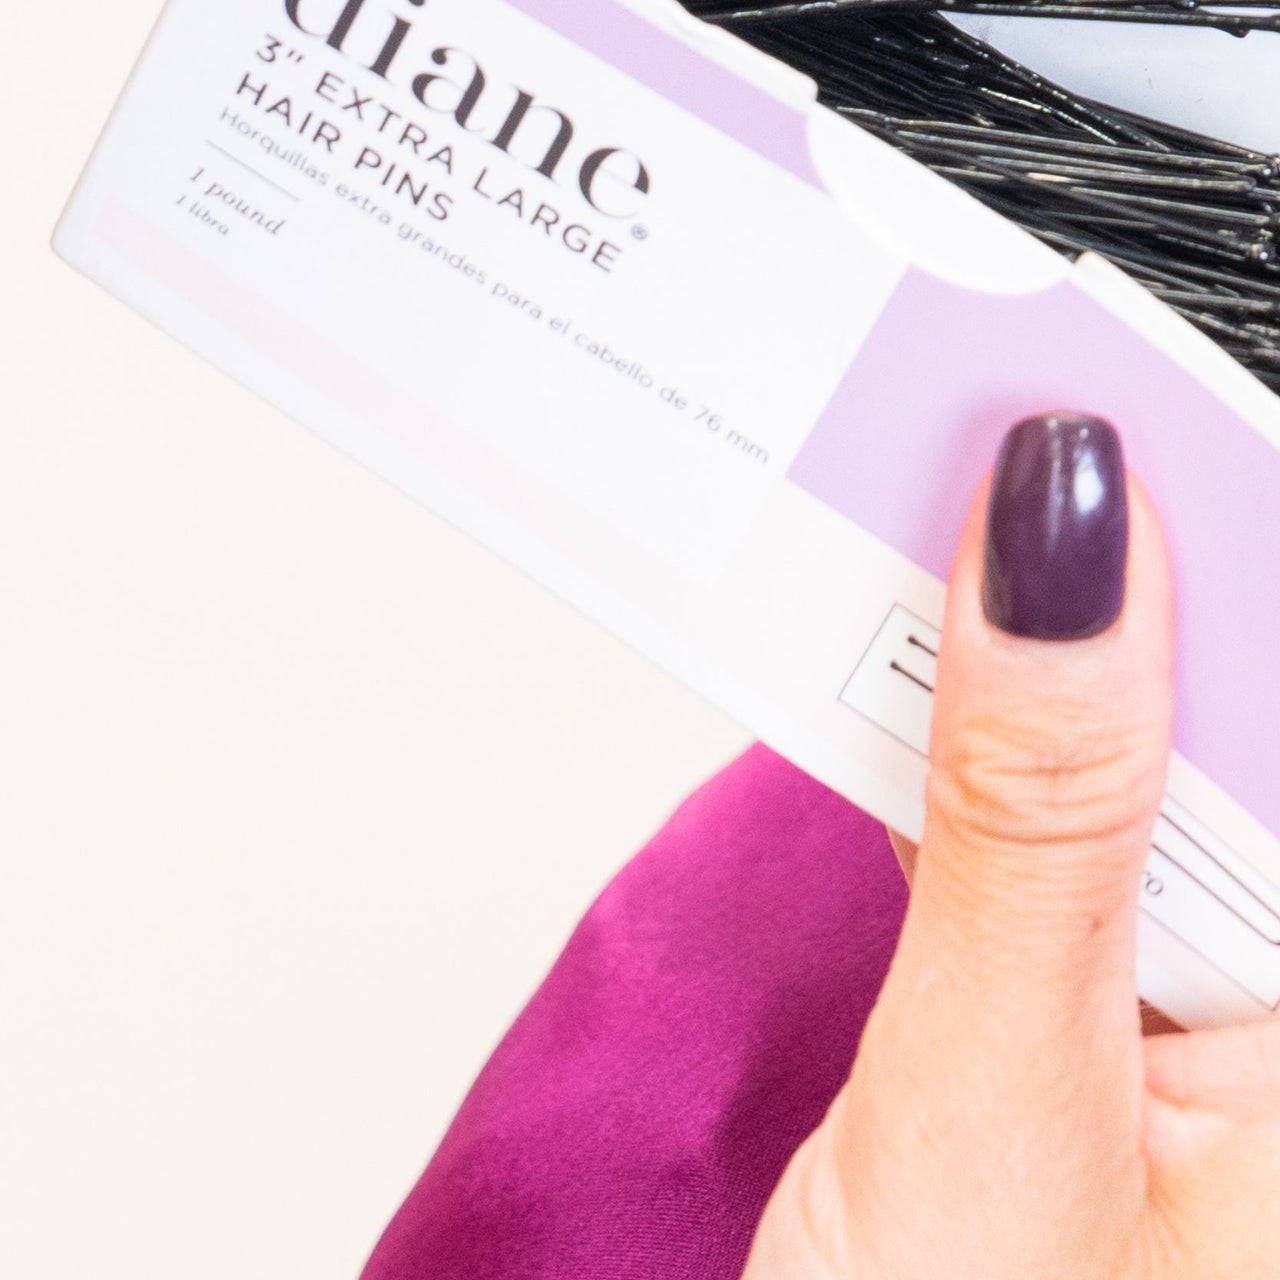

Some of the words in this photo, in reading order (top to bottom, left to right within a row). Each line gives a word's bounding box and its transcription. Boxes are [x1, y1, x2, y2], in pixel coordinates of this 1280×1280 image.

[188, 200, 231, 237] libra
[203, 181, 287, 236] pound
[235, 72, 341, 153] HAIR
[354, 146, 456, 222] PINS
[315, 70, 456, 175] EXTRA
[473, 167, 623, 273] LARGE
[219, 105, 330, 187] Horquillas
[335, 182, 393, 226] extra
[397, 221, 488, 285] grandes
[491, 281, 543, 321] para
[549, 316, 572, 336] el
[574, 331, 653, 389] cabello
[658, 384, 688, 411] de
[694, 403, 722, 432] 76
[726, 429, 770, 465] mm
